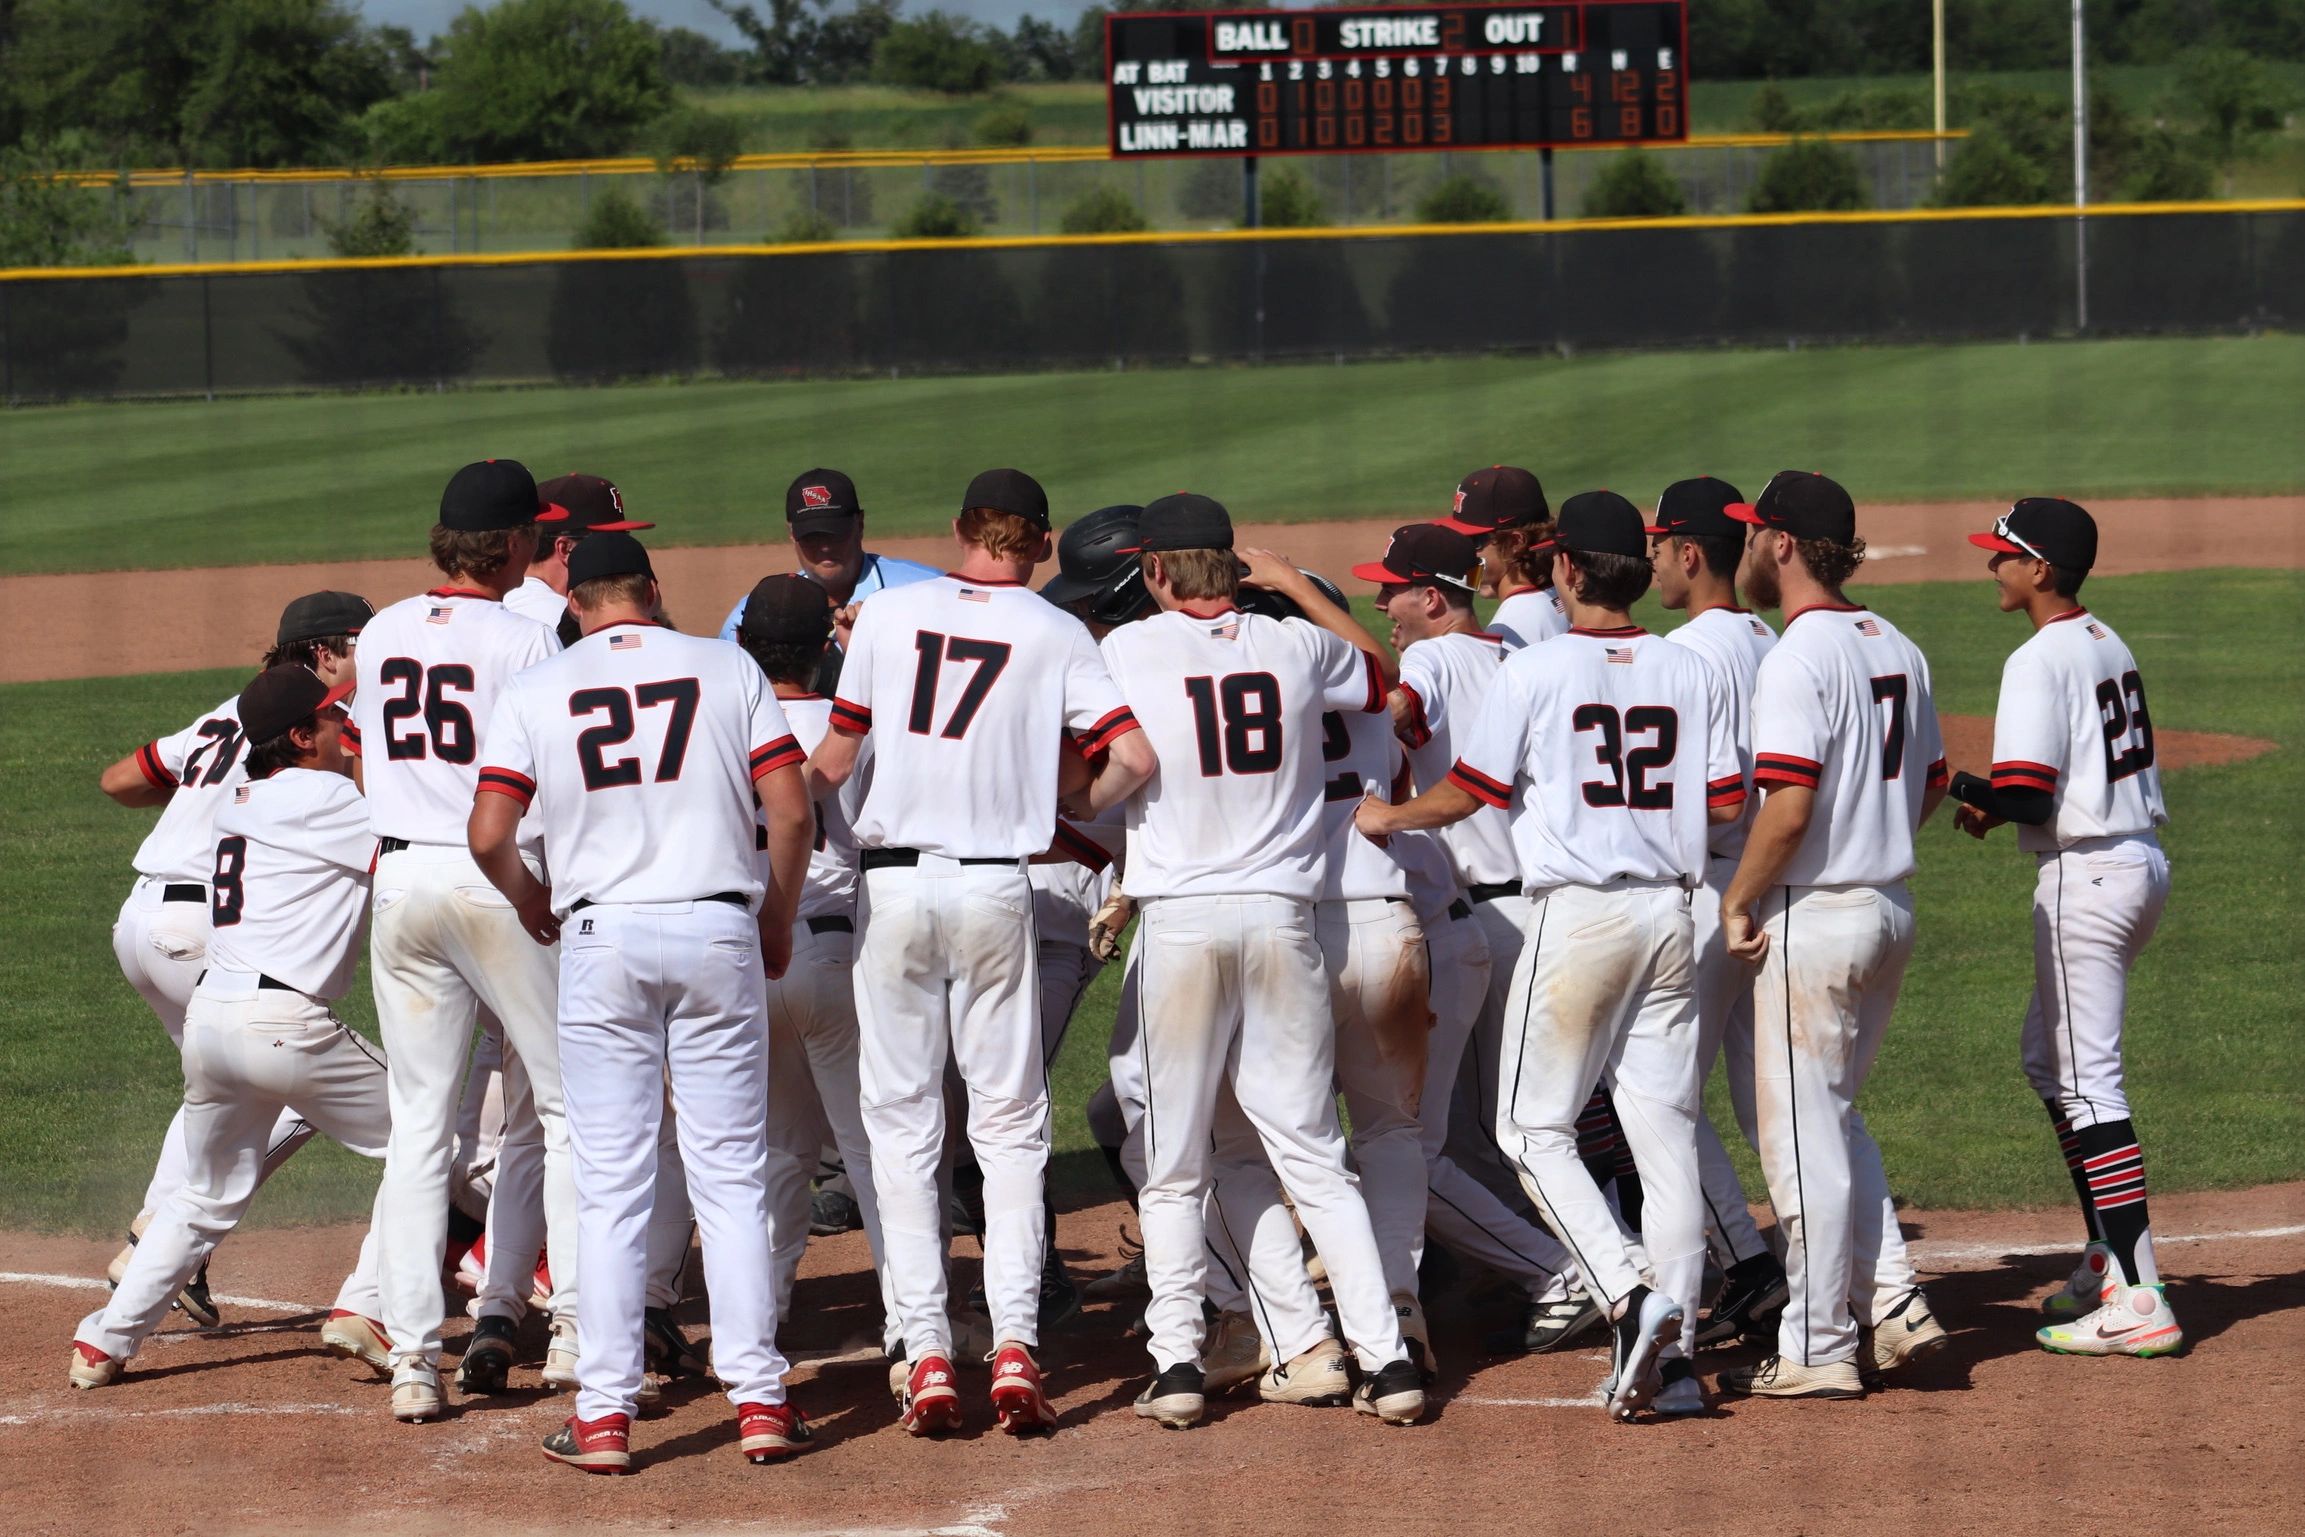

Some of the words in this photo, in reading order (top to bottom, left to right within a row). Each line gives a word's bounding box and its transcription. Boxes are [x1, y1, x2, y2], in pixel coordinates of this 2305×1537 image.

[1113, 61, 1141, 84] AT
[1147, 59, 1189, 83] BAT
[1215, 22, 1289, 51] BALL
[1293, 17, 1315, 54] 0
[1339, 17, 1440, 48] STRIKE
[1442, 13, 1465, 50] 2
[1484, 13, 1544, 44] OUT
[1259, 61, 1273, 81] 1
[1288, 59, 1303, 80] 2
[1316, 58, 1333, 79] 3
[1345, 58, 1361, 79] 4
[1375, 56, 1391, 78] 5
[1403, 55, 1420, 77] 6
[1434, 54, 1449, 76] 7
[1461, 53, 1477, 75] 8
[1490, 53, 1506, 75] 9
[1516, 52, 1540, 73] 10
[1657, 48, 1673, 70] E
[1119, 120, 1248, 150] LINN-MAR
[1133, 85, 1235, 115] VISITOR
[381, 657, 476, 765] 26
[908, 629, 1012, 740] 17
[1184, 671, 1283, 777] 18
[1870, 674, 1907, 781] 7
[2096, 670, 2154, 784] 23
[568, 677, 701, 792] 27
[1573, 704, 1678, 810] 32
[213, 836, 247, 928] 8
[585, 1430, 611, 1443] UNDER
